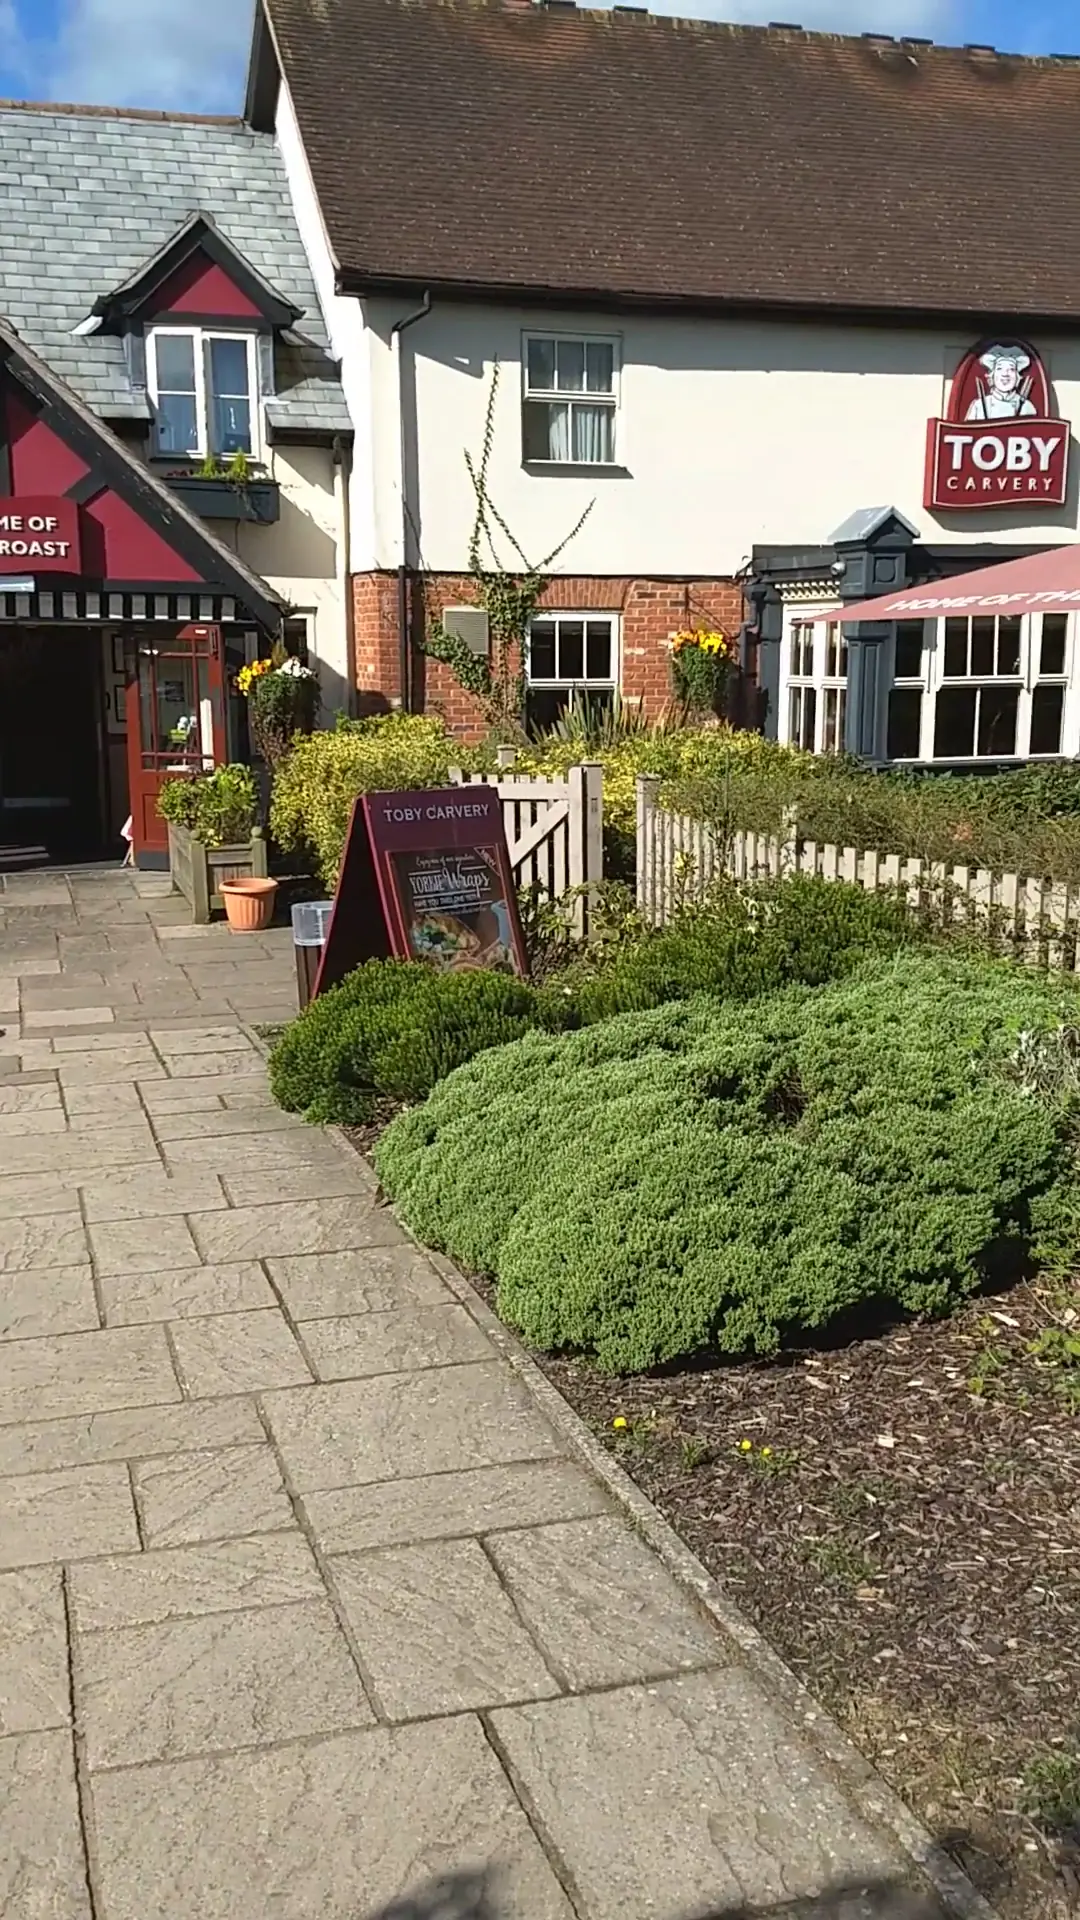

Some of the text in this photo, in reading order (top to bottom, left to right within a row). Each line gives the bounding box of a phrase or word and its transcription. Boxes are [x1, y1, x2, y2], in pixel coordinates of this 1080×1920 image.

[943, 434, 1062, 471] TOBY
[946, 476, 1054, 491] CARVERY
[28, 516, 57, 532] OF
[0, 539, 70, 557] ROAST
[884, 595, 979, 612] HOME
[976, 592, 1032, 607] OF
[383, 803, 489, 823] TOBY CARVERY
[442, 864, 490, 898] Wraps
